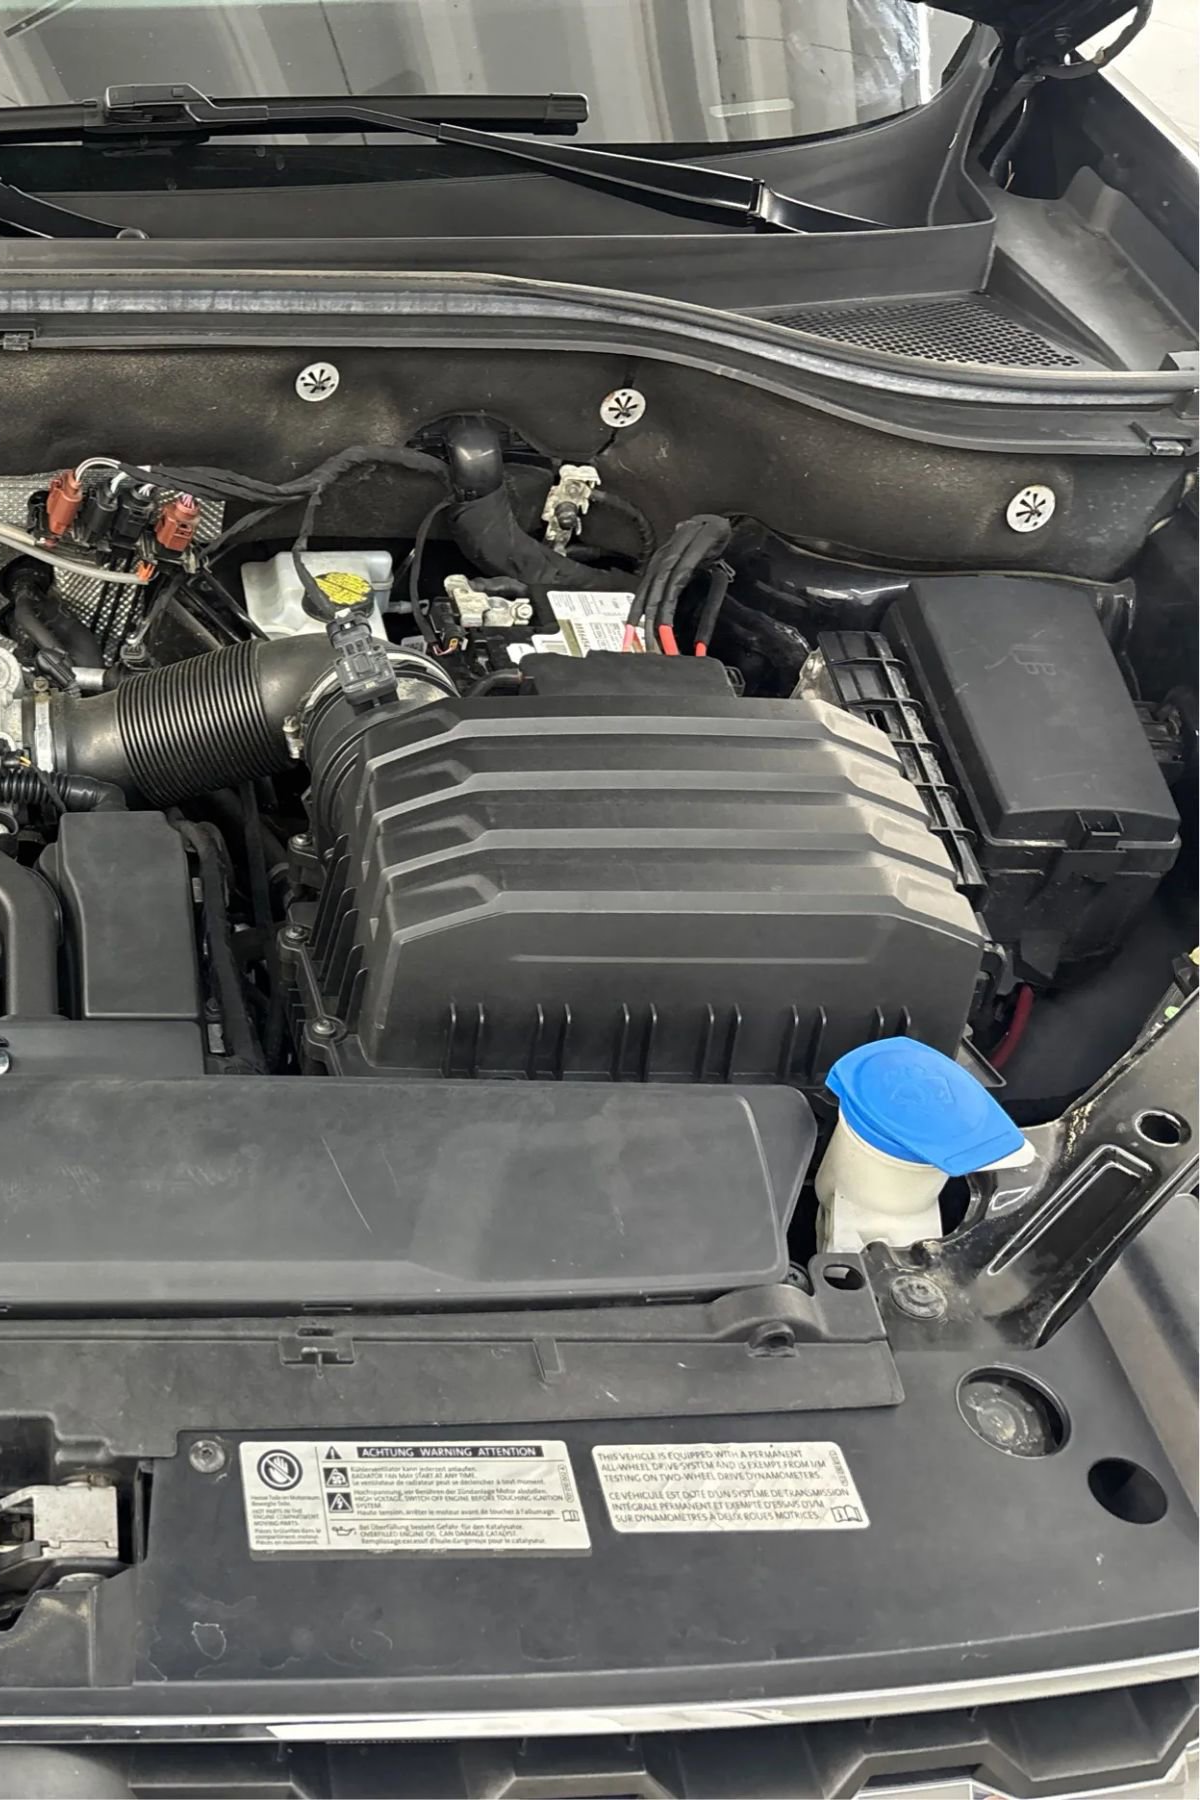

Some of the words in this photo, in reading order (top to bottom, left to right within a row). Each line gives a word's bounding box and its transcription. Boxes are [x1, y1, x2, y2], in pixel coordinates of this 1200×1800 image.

[361, 1447, 414, 1458] ACHTUNG
[419, 1447, 472, 1457] WARNING
[478, 1446, 537, 1457] ATTENTION
[598, 1452, 618, 1461] THIS
[620, 1452, 656, 1461] VEHICLE
[657, 1452, 667, 1461] IS
[667, 1450, 713, 1461] EQUIPPED
[715, 1450, 739, 1459] WITH
[739, 1450, 748, 1459] A
[748, 1449, 803, 1459] PERMANENT
[601, 1463, 652, 1472] ALL-WHEEL
[652, 1462, 679, 1471] DRIVE
[679, 1461, 714, 1471] SYSTEM
[715, 1461, 737, 1470] AND
[738, 1461, 747, 1470] IS
[746, 1460, 783, 1470] EXEMPT
[783, 1460, 810, 1469] FROM
[604, 1473, 641, 1483] TESTING
[642, 1474, 658, 1483] ON
[658, 1472, 716, 1482] TWO-WHEEL
[716, 1471, 745, 1481] DRIVE
[445, 1494, 470, 1502] ENGINE
[471, 1494, 496, 1502] BEFORE
[497, 1494, 533, 1502] TOUCHING
[533, 1494, 565, 1502] IGNITION
[608, 1491, 621, 1501] CE
[666, 1490, 681, 1500] EST
[771, 1488, 783, 1497] DE
[783, 1486, 850, 1498] TRANSMISSION
[659, 1501, 714, 1511] PERMANENT
[714, 1500, 724, 1510] ET
[614, 1513, 634, 1523] SUR
[744, 1510, 775, 1520] ROUES
